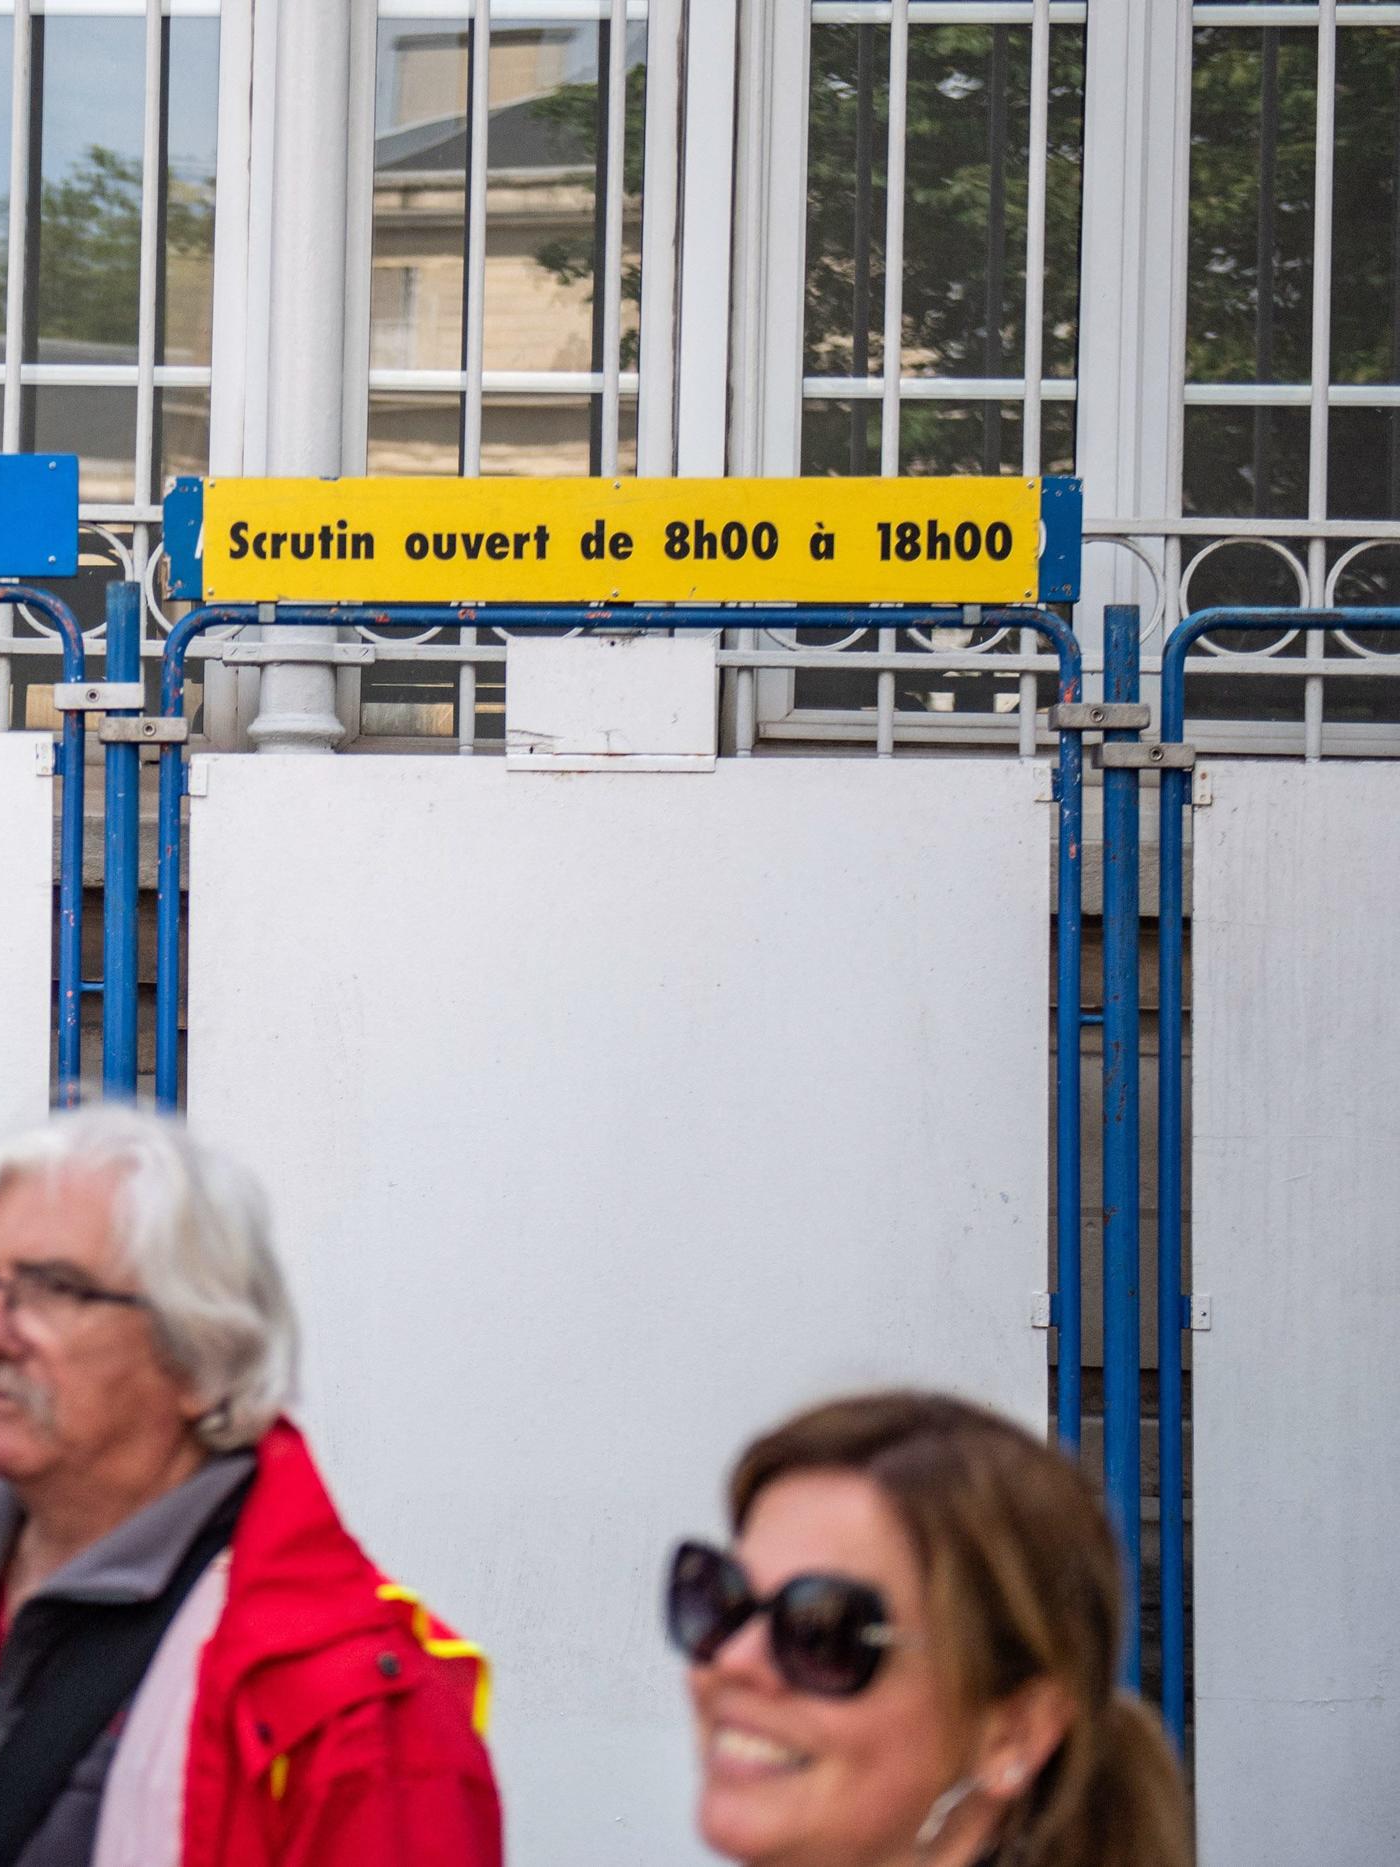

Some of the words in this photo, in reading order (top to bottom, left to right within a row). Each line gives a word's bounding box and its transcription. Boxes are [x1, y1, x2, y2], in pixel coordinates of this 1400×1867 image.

[229, 519, 374, 560] Scrutin
[405, 525, 550, 561] ouvert
[580, 519, 634, 561] de
[664, 519, 779, 561] 8h00
[809, 521, 835, 561] à
[877, 519, 1013, 562] 18h00
